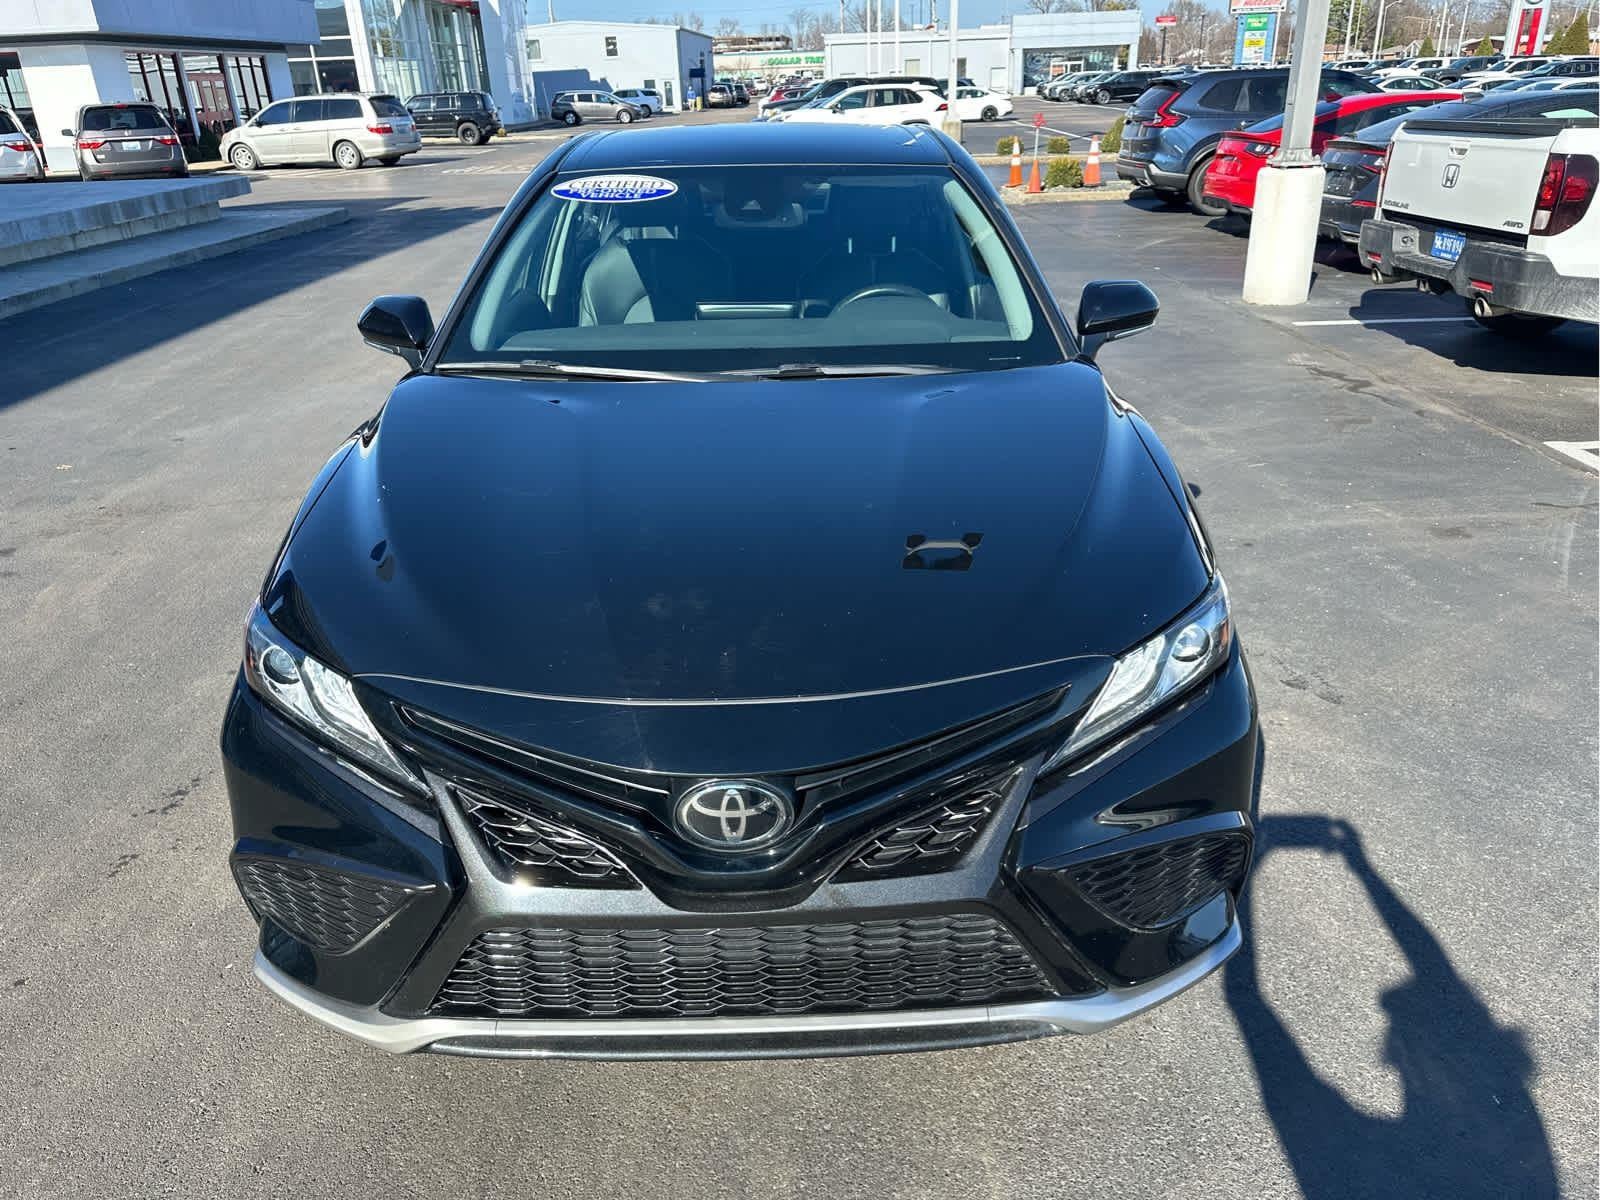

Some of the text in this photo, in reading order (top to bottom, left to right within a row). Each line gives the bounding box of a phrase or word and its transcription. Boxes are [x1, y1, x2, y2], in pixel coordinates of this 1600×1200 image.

[768, 57, 802, 66] DOLLAR
[568, 180, 665, 189] CERTIFIED
[568, 187, 657, 195] PRE-OWNED
[1502, 220, 1524, 229] AWD
